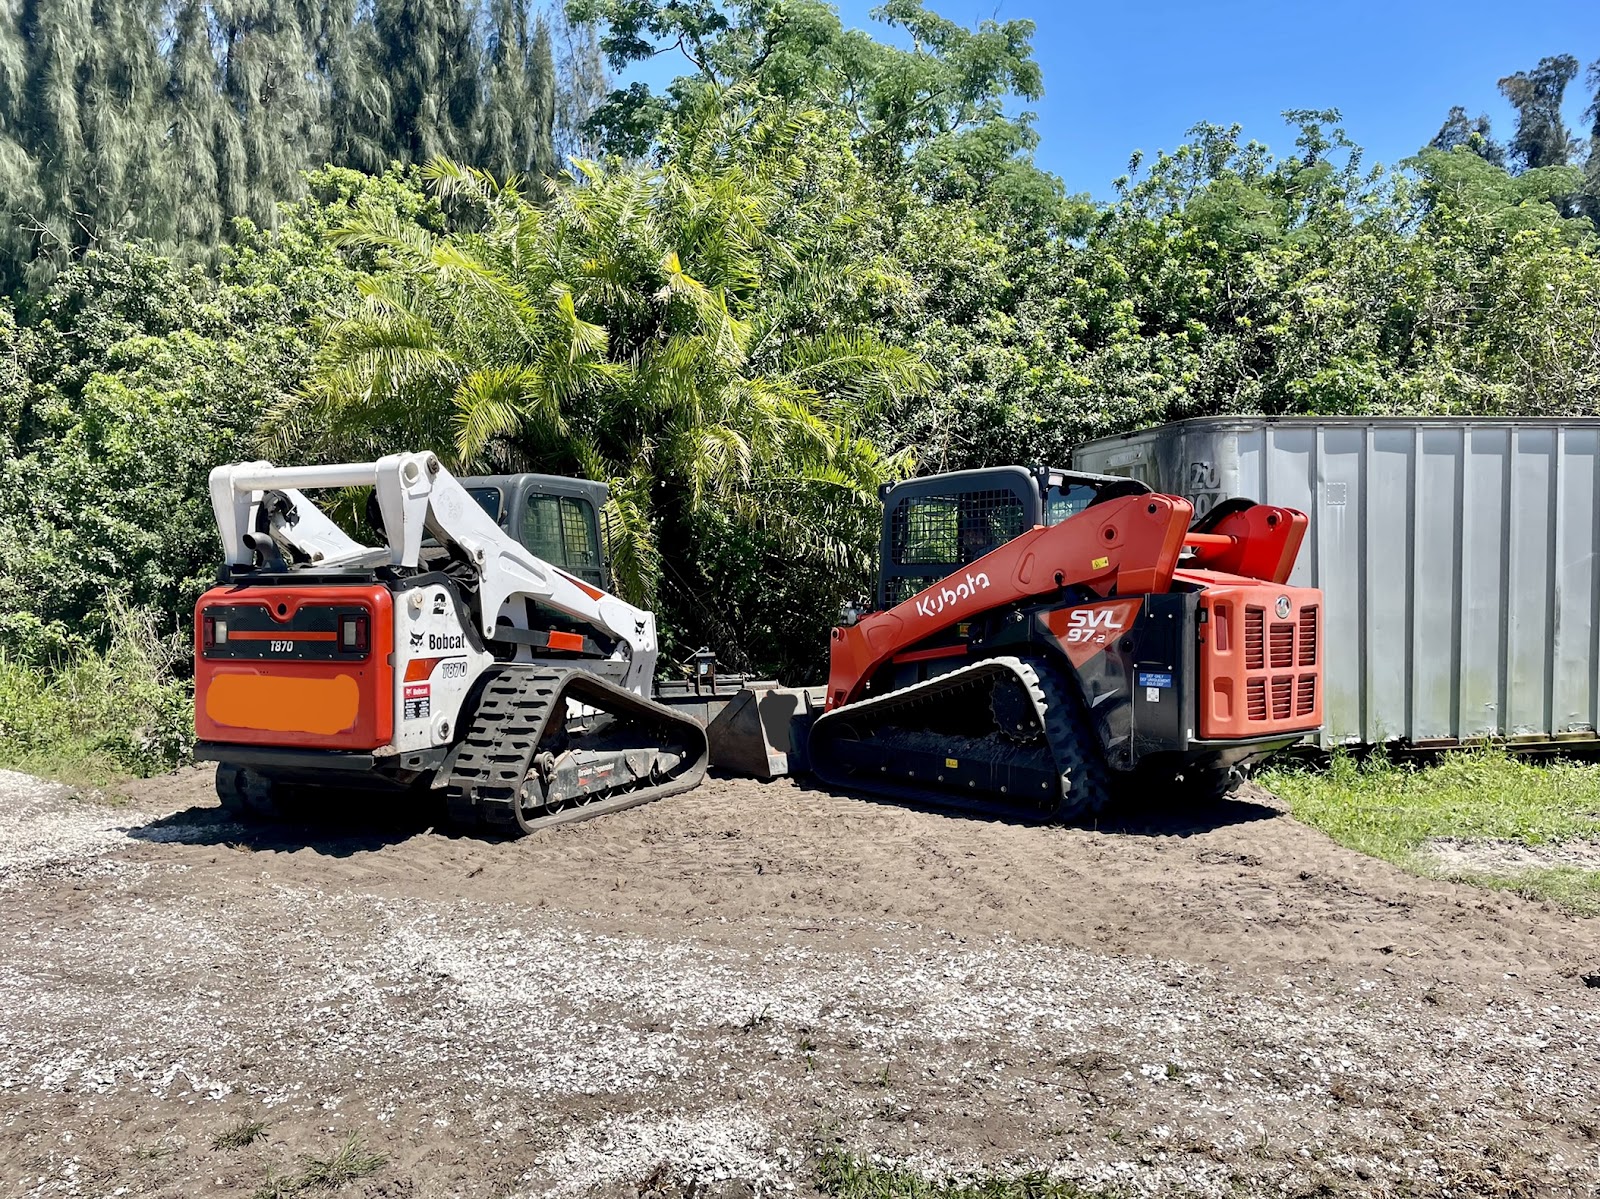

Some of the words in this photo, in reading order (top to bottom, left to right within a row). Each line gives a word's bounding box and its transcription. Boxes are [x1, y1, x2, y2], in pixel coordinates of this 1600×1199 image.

[915, 572, 991, 617] Kubota
[1067, 609, 1122, 628] SVL
[429, 633, 465, 651] Bobcat
[1067, 628, 1106, 643] 97-2
[270, 640, 294, 652] T870
[442, 662, 468, 679] T870
